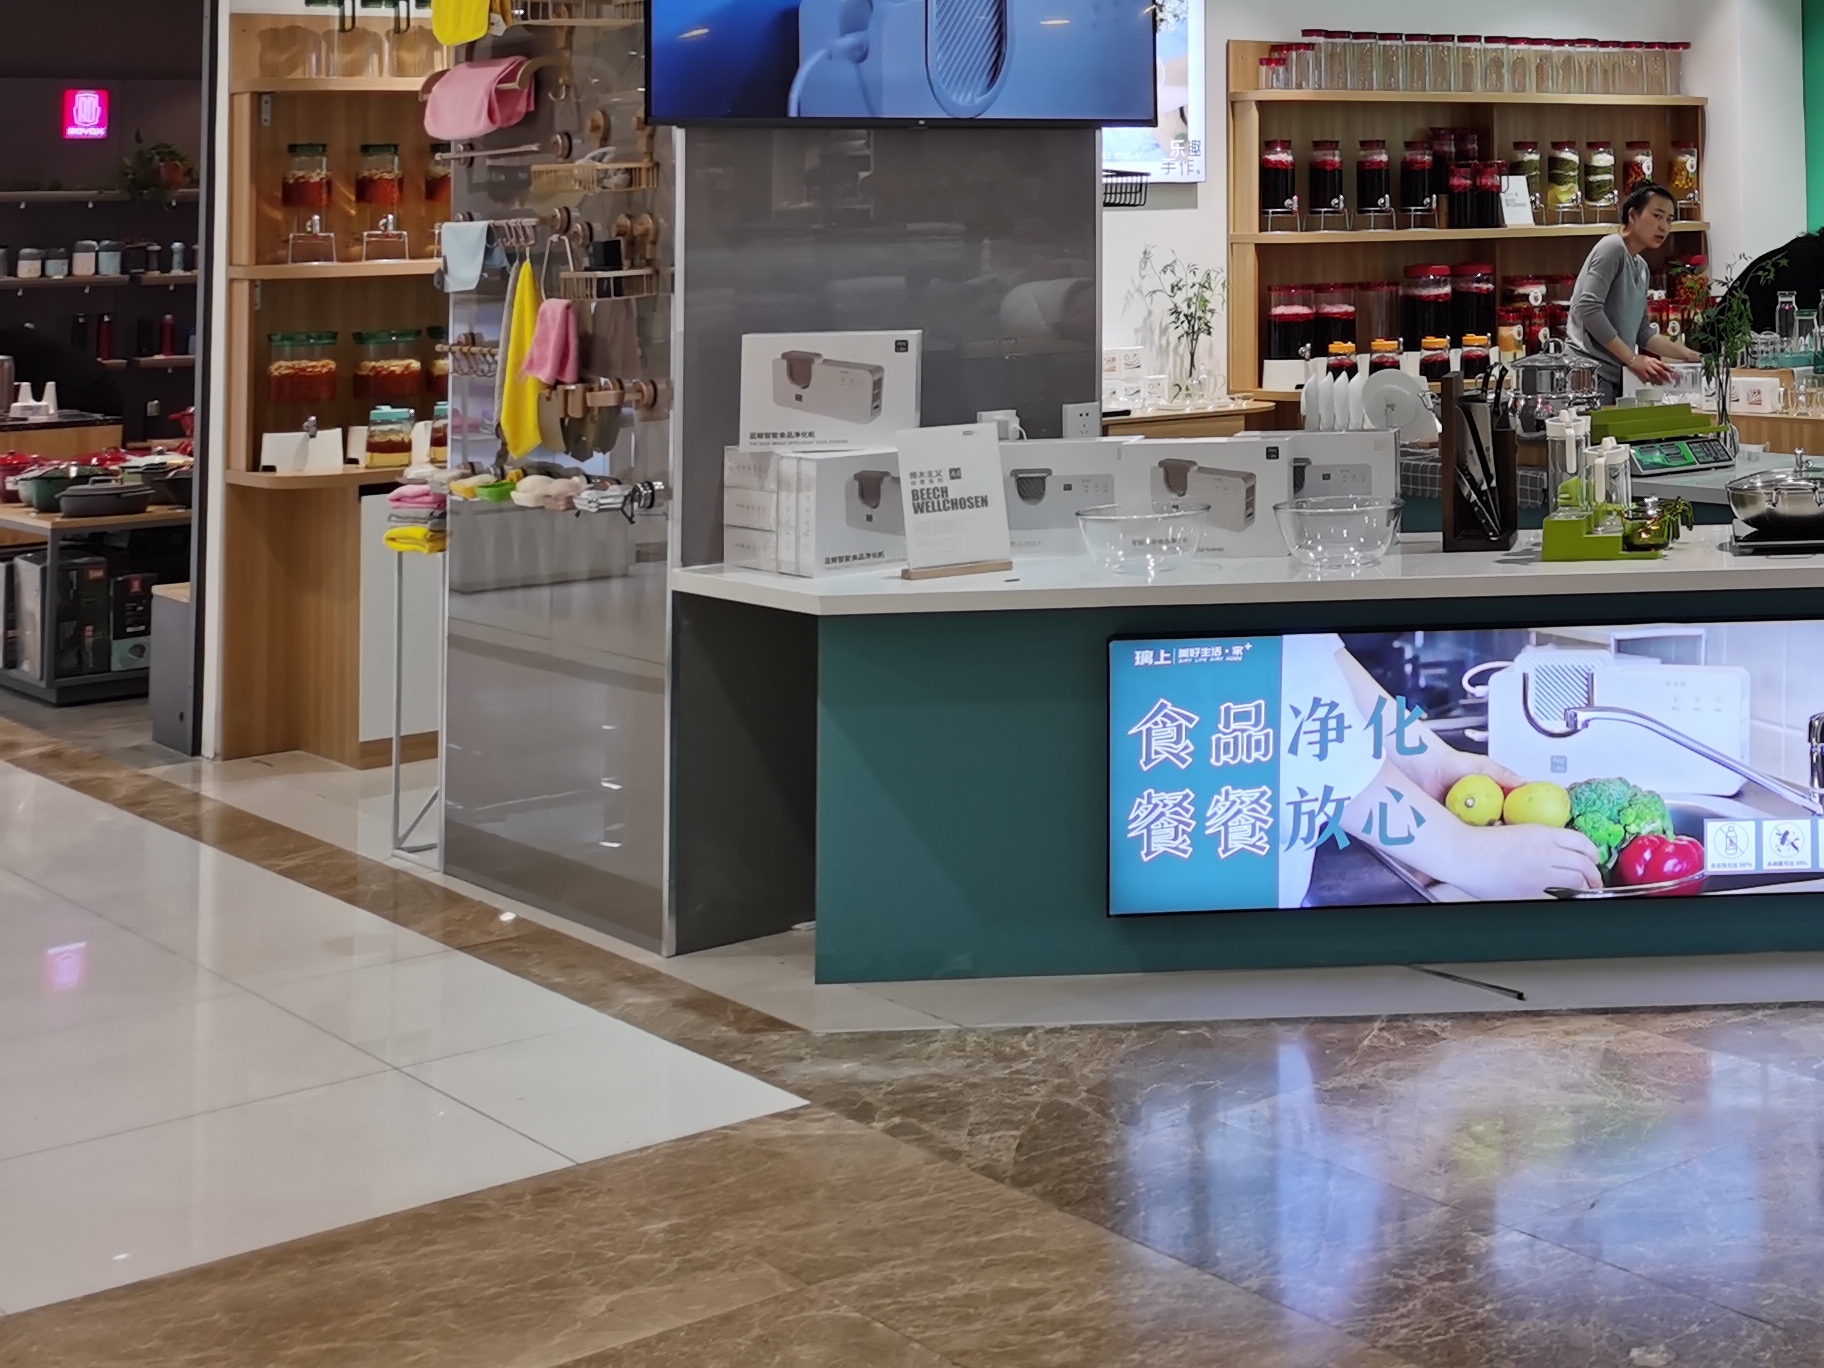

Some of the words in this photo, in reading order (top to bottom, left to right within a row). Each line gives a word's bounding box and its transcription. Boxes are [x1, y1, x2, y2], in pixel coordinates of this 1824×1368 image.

[1169, 139, 1201, 157] 乐趣
[911, 486, 949, 502] BEECH
[912, 495, 989, 515] WELLCHOSEN
[1134, 648, 1172, 667] 璃上
[1127, 695, 1430, 772] 食品净化
[1127, 785, 1425, 862] 餐餐放心
